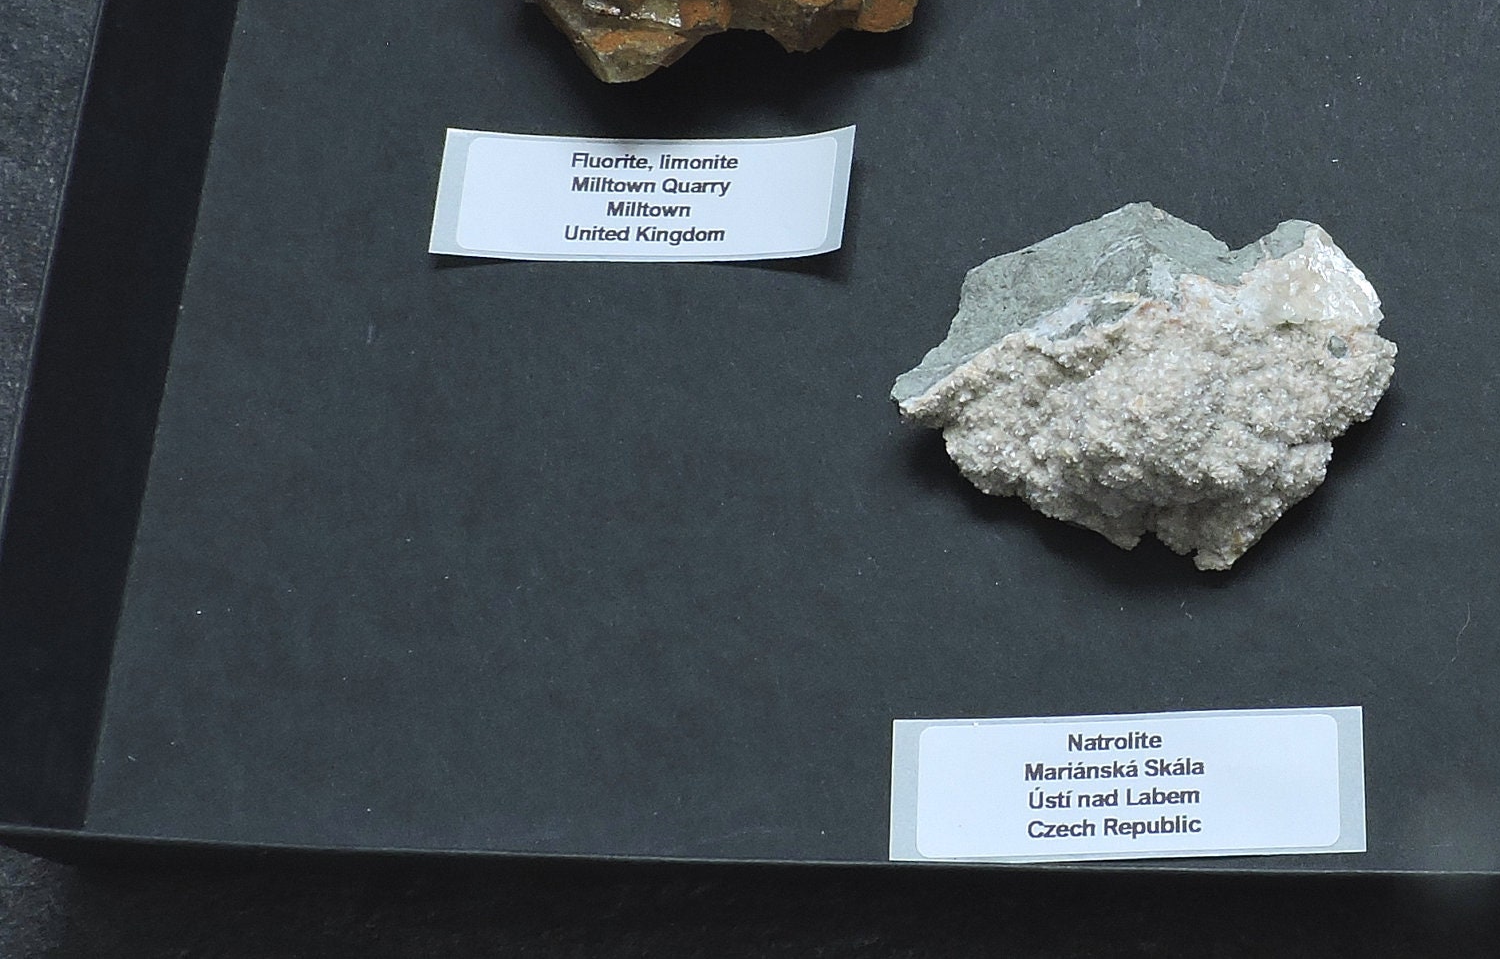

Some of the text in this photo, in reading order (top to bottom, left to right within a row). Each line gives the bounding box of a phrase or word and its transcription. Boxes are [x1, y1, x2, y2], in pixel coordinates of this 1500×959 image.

[571, 153, 739, 171] Fluorite, limonite
[571, 176, 731, 197] Milltown Quarry
[606, 201, 691, 217] Milltown
[564, 225, 725, 245] United Kingdom
[1068, 732, 1162, 752] Natrolite
[1024, 758, 1205, 781] Mariánská Skála
[1029, 787, 1200, 809] Ústí nad Labem
[1028, 815, 1201, 839] Czech Republic
